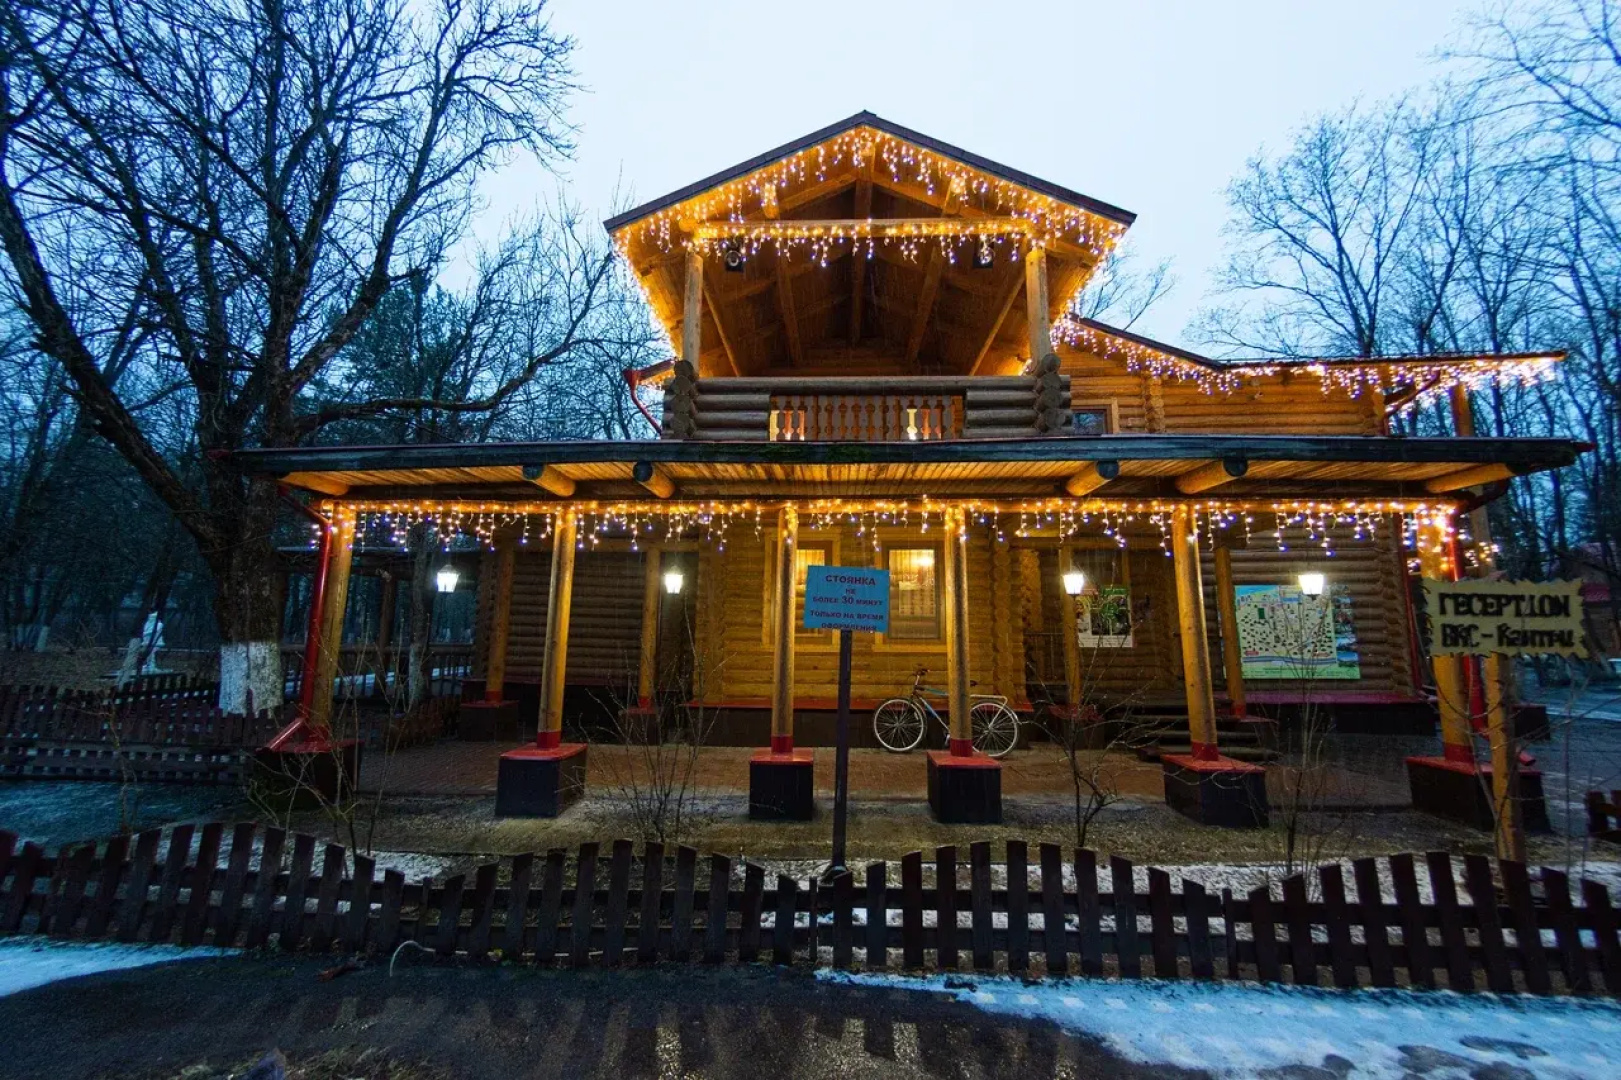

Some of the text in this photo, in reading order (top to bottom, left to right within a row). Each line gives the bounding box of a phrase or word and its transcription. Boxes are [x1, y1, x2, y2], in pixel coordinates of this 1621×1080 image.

[825, 575, 876, 586] СТОЯНКА
[812, 596, 838, 604] БОЛЕЕ
[841, 595, 854, 605] 30
[810, 610, 841, 618] ТОЛЬКО
[821, 622, 877, 631] ОФОРМЛЕНИЯ
